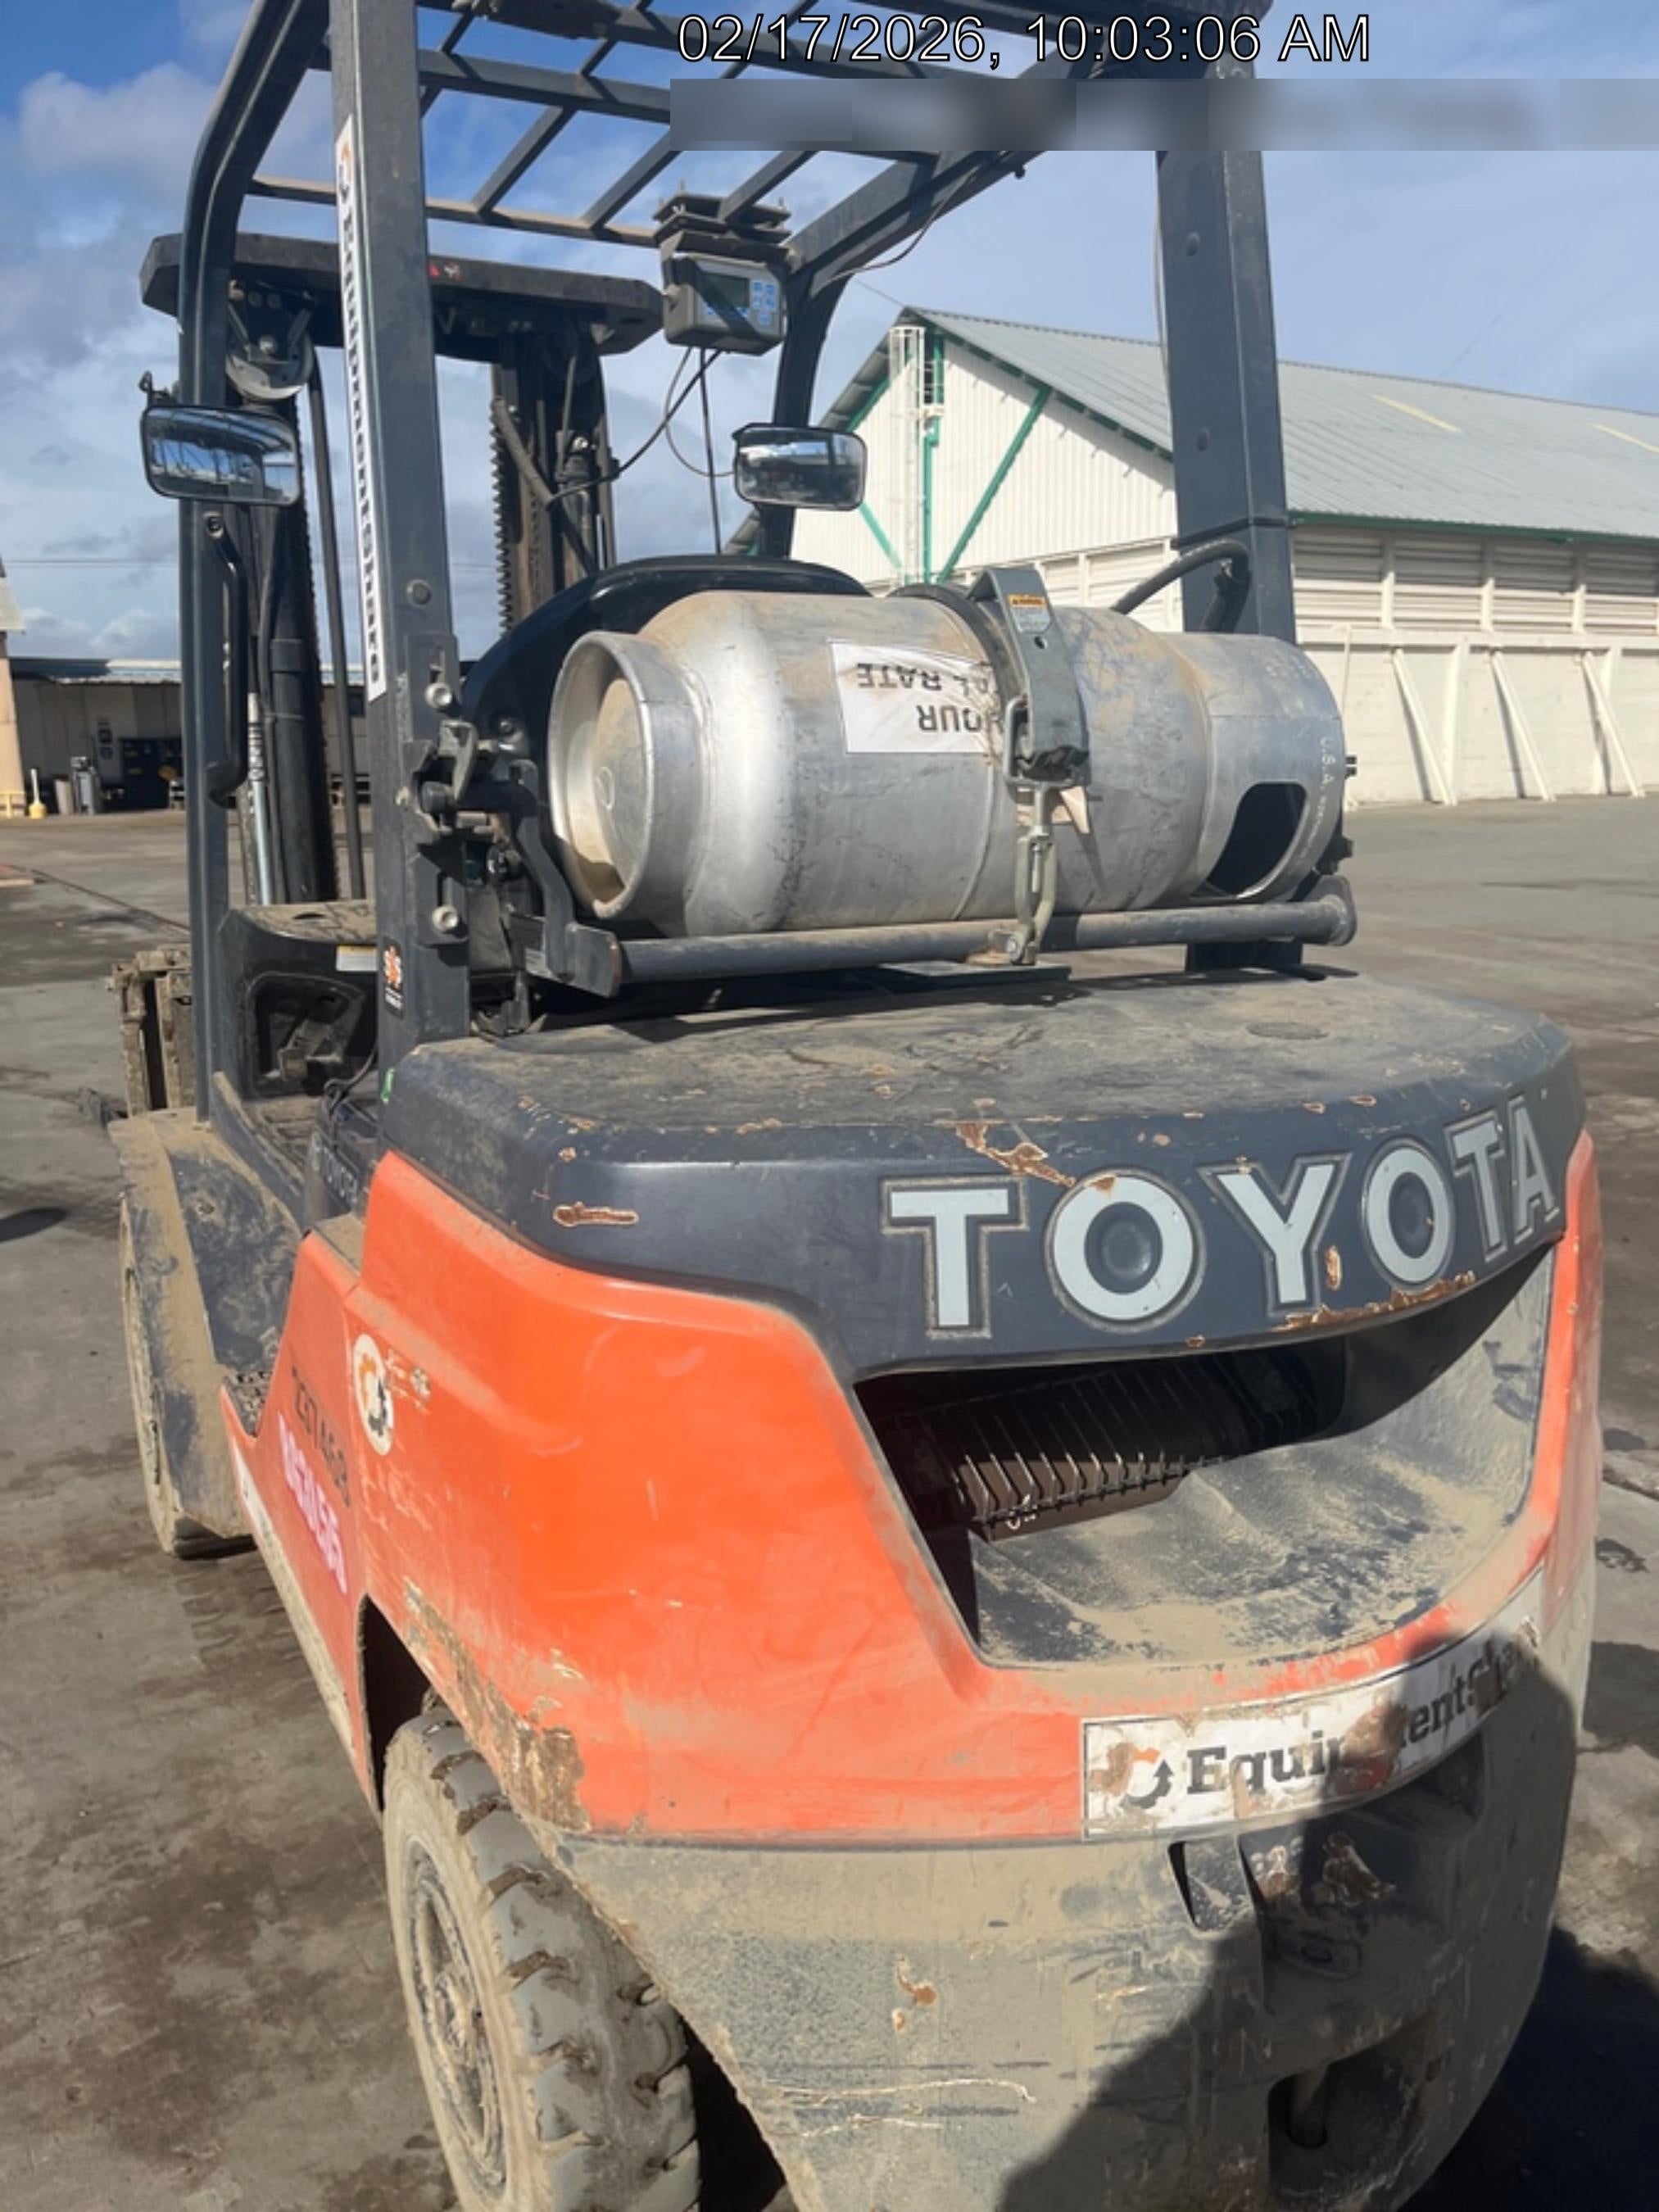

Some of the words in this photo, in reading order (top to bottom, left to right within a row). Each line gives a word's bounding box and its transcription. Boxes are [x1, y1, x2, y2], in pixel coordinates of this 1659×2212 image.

[857, 663, 942, 691] RATE
[916, 705, 1001, 732] OUR
[882, 1095, 1560, 1339] TOYOTA
